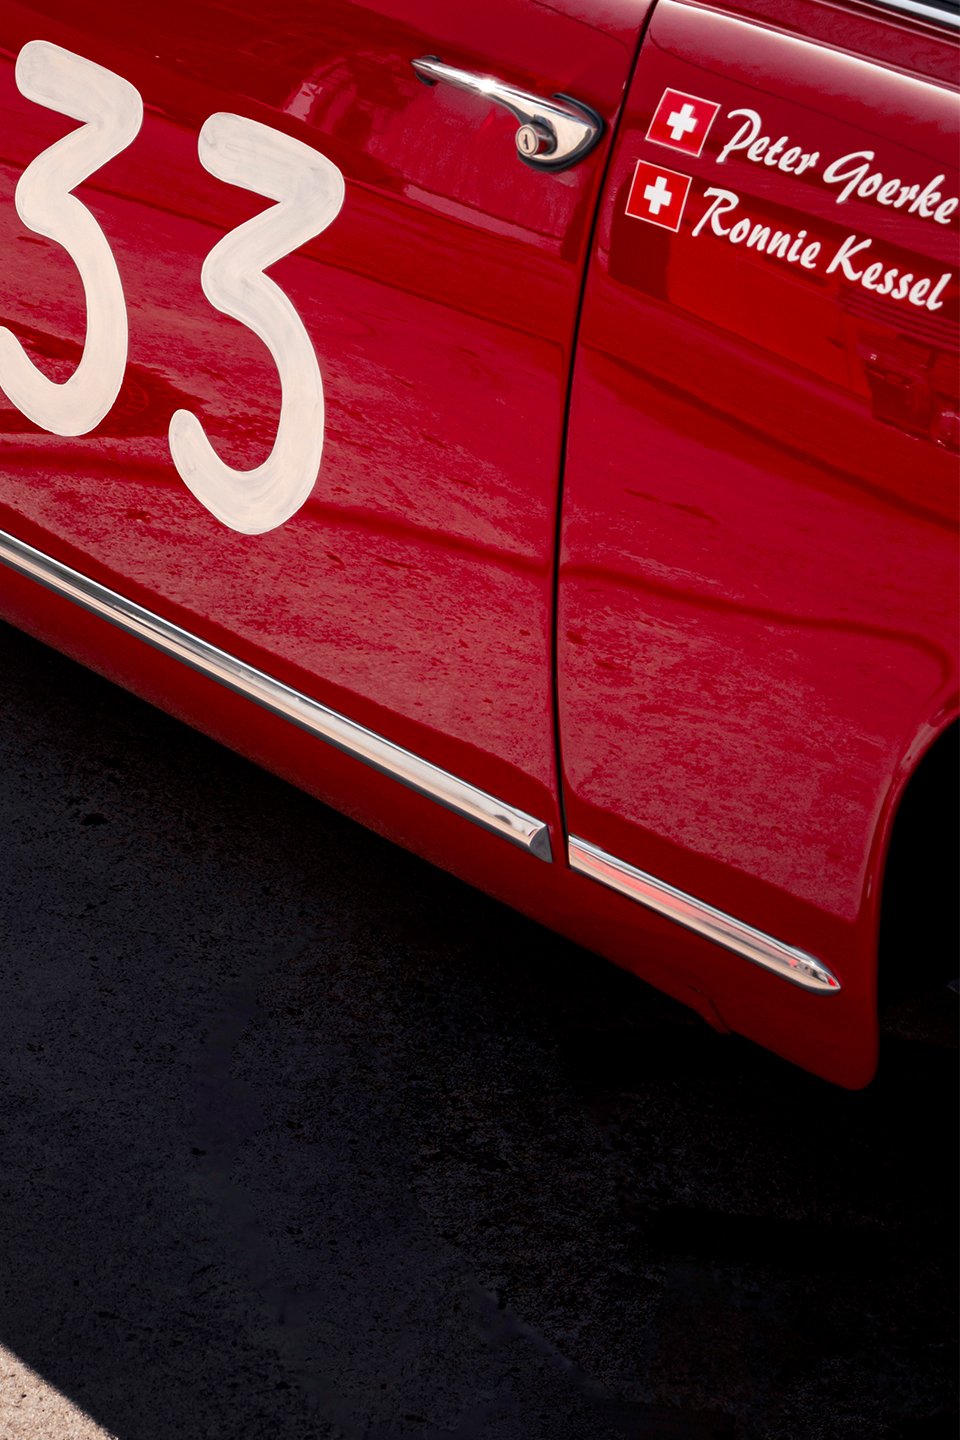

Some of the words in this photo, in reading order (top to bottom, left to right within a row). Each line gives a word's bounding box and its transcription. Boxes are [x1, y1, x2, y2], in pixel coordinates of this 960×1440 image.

[716, 108, 820, 175] Peter
[822, 150, 960, 224] Goerke
[691, 187, 822, 269] Ronnie
[826, 234, 952, 311] Kessel
